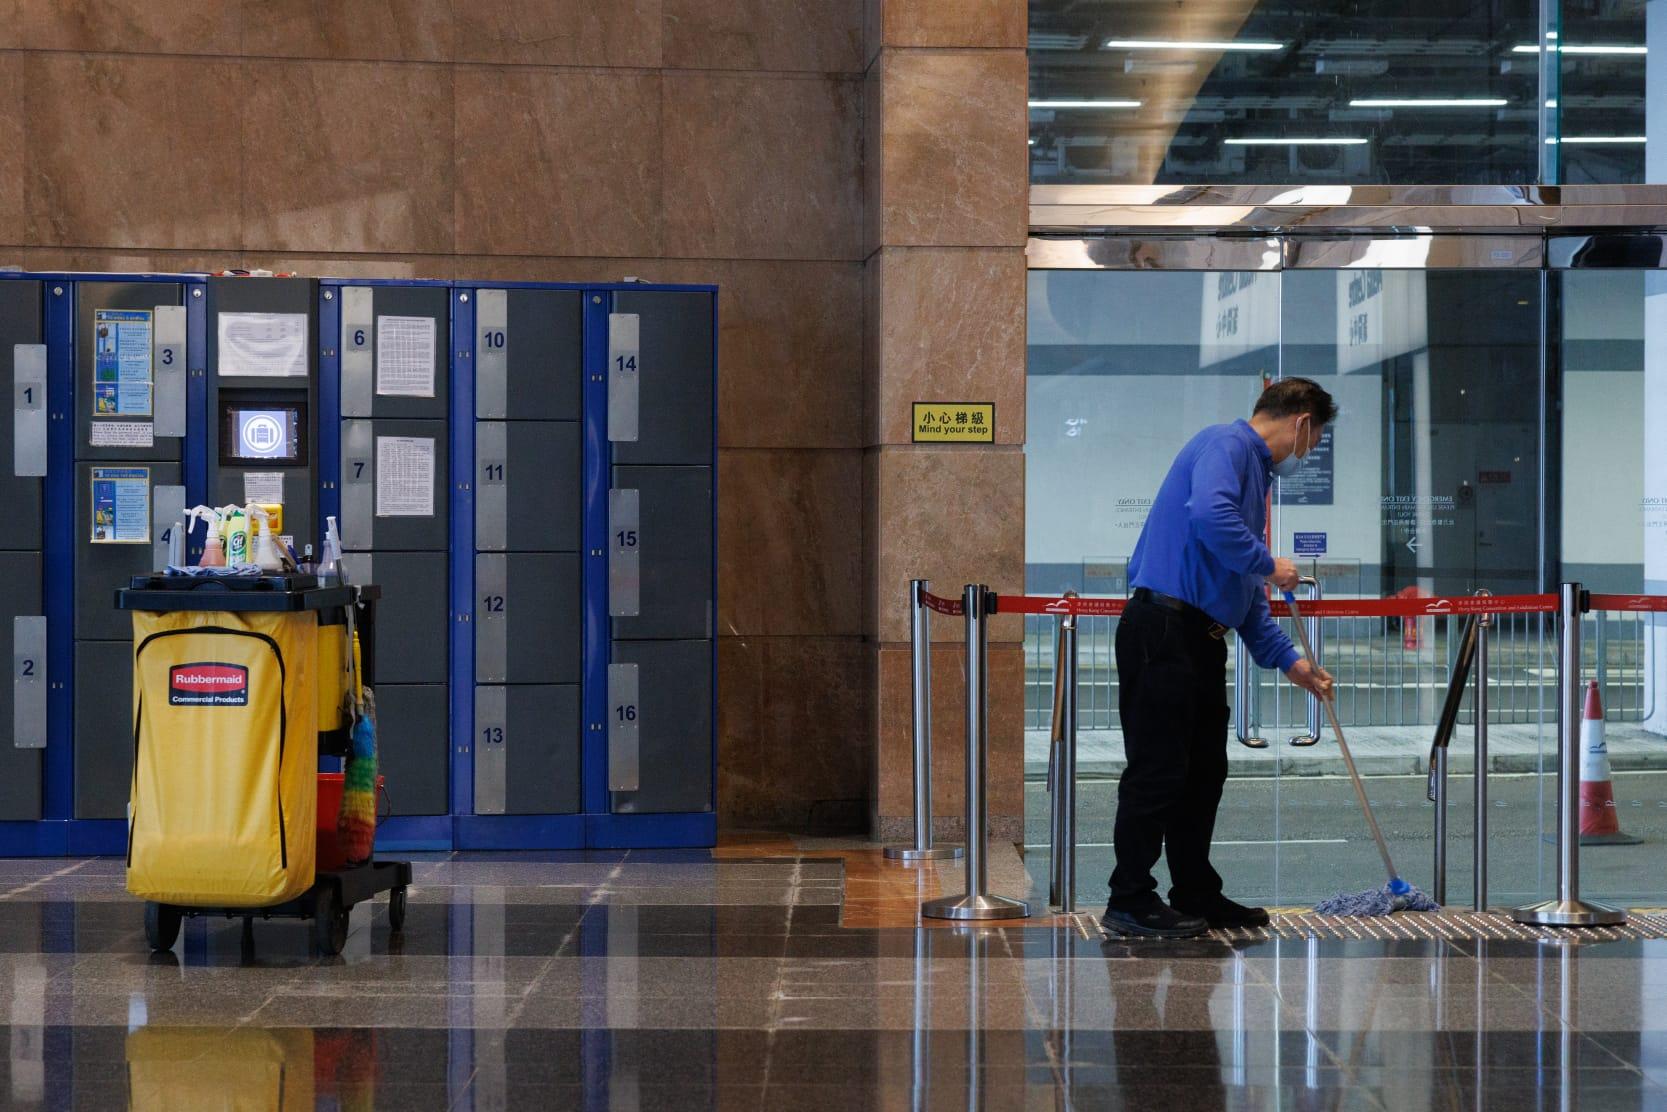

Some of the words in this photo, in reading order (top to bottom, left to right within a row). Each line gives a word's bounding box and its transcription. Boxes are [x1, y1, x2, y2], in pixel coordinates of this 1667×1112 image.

[354, 330, 365, 346] 6
[485, 332, 504, 348] 10
[163, 349, 173, 364] 3
[616, 356, 636, 372] 14
[24, 389, 32, 403] 1
[923, 412, 983, 424] 小心梯級
[944, 426, 965, 434] your
[968, 426, 988, 434] step
[354, 463, 364, 478] 7
[485, 465, 503, 481] 11
[161, 528, 170, 544] 4
[617, 531, 637, 547] 15
[484, 596, 503, 612] 12
[22, 660, 34, 676] 2
[176, 674, 242, 684] Rubbermaid
[616, 705, 636, 721] 16
[483, 728, 503, 743] 13
